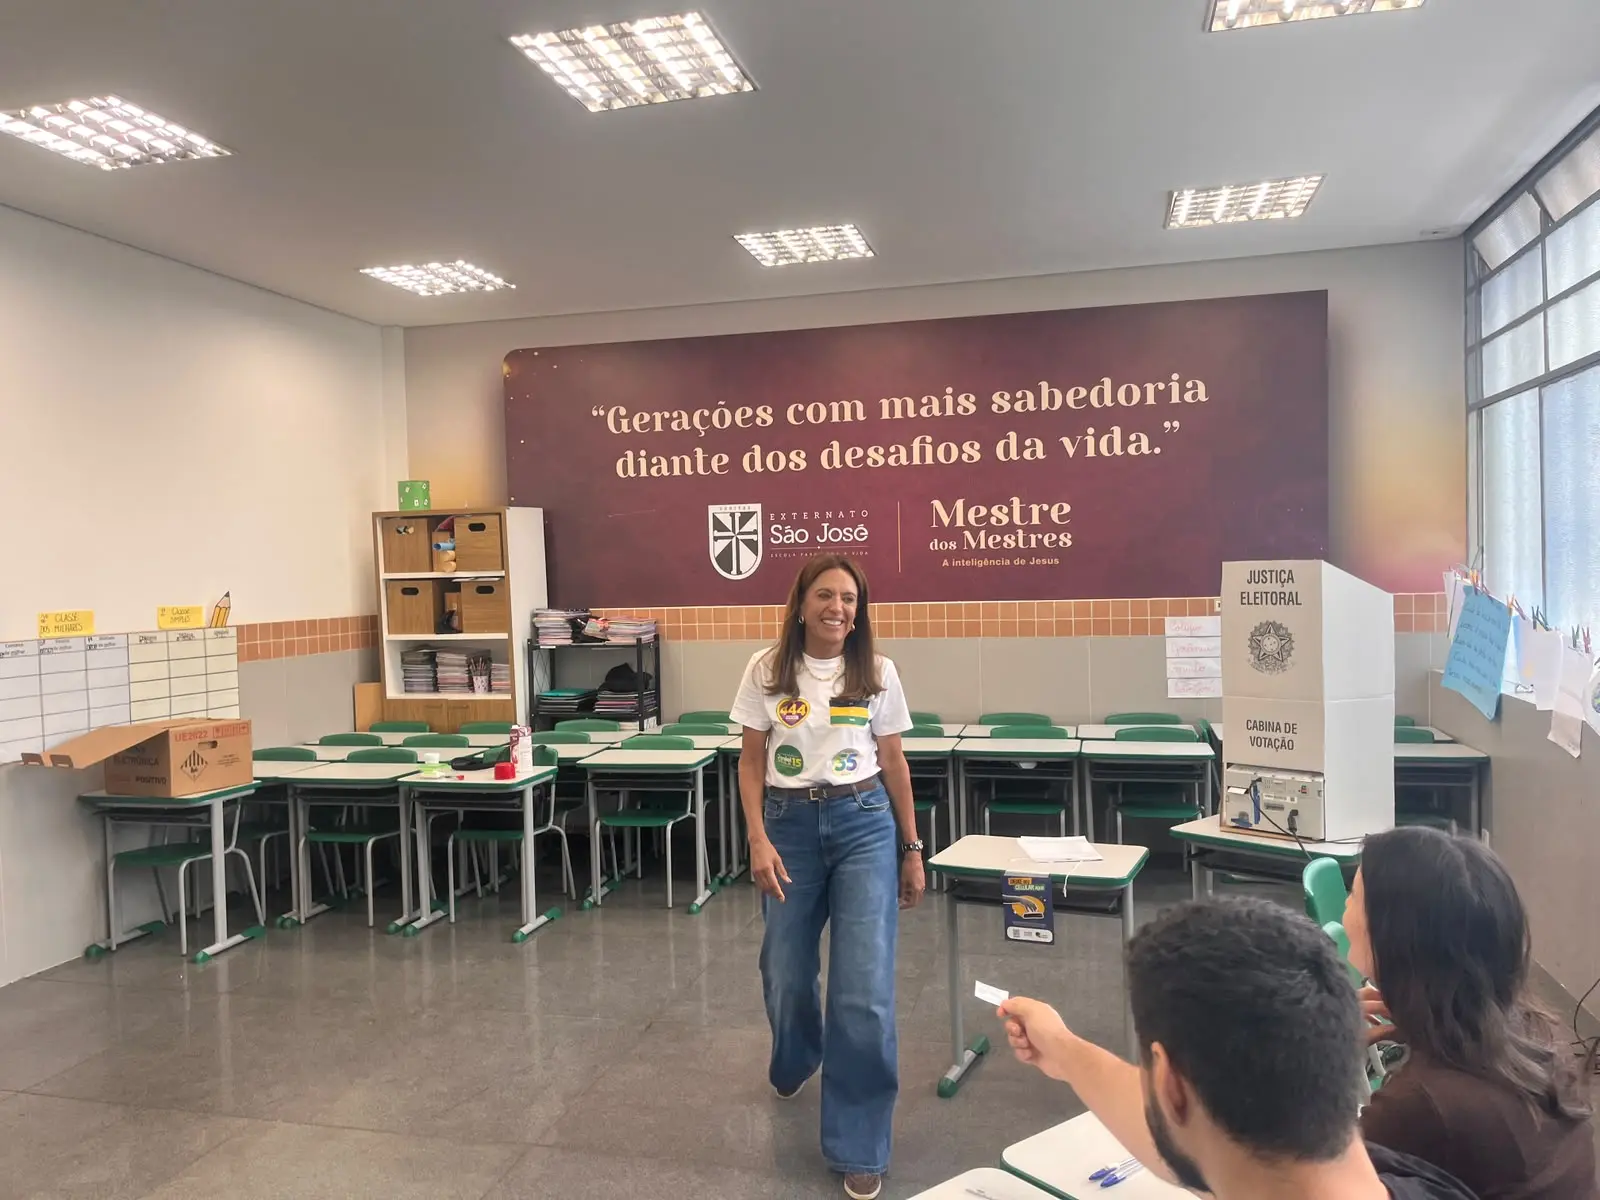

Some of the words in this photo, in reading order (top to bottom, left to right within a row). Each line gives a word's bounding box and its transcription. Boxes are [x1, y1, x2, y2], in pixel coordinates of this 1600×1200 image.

[591, 400, 775, 438] “Gerações
[786, 398, 867, 426] com
[879, 386, 977, 420] mais
[990, 372, 1209, 415] sabedoria
[615, 446, 730, 479] diante
[742, 444, 808, 474] dos
[820, 434, 981, 470] desafios
[995, 431, 1047, 462] da
[1058, 420, 1181, 459] vida.”
[769, 509, 869, 521] EXTERNATO
[930, 496, 1072, 528] Mestre
[769, 523, 809, 545] São
[816, 521, 869, 543] José
[929, 538, 957, 551] dos
[962, 528, 1073, 550] Mestres
[942, 559, 949, 567] A
[952, 557, 1011, 568] inteligência
[1013, 556, 1026, 566] de
[1029, 556, 1060, 566] Jesus
[1246, 569, 1295, 588] JUSTIÇA
[1240, 591, 1303, 606] ELEITORAL
[1246, 719, 1281, 734] CABINA
[1284, 722, 1298, 735] DE
[1249, 735, 1295, 752] VOTAÇÃO
[791, 757, 802, 768] 15
[134, 775, 167, 785] POSITIVO
